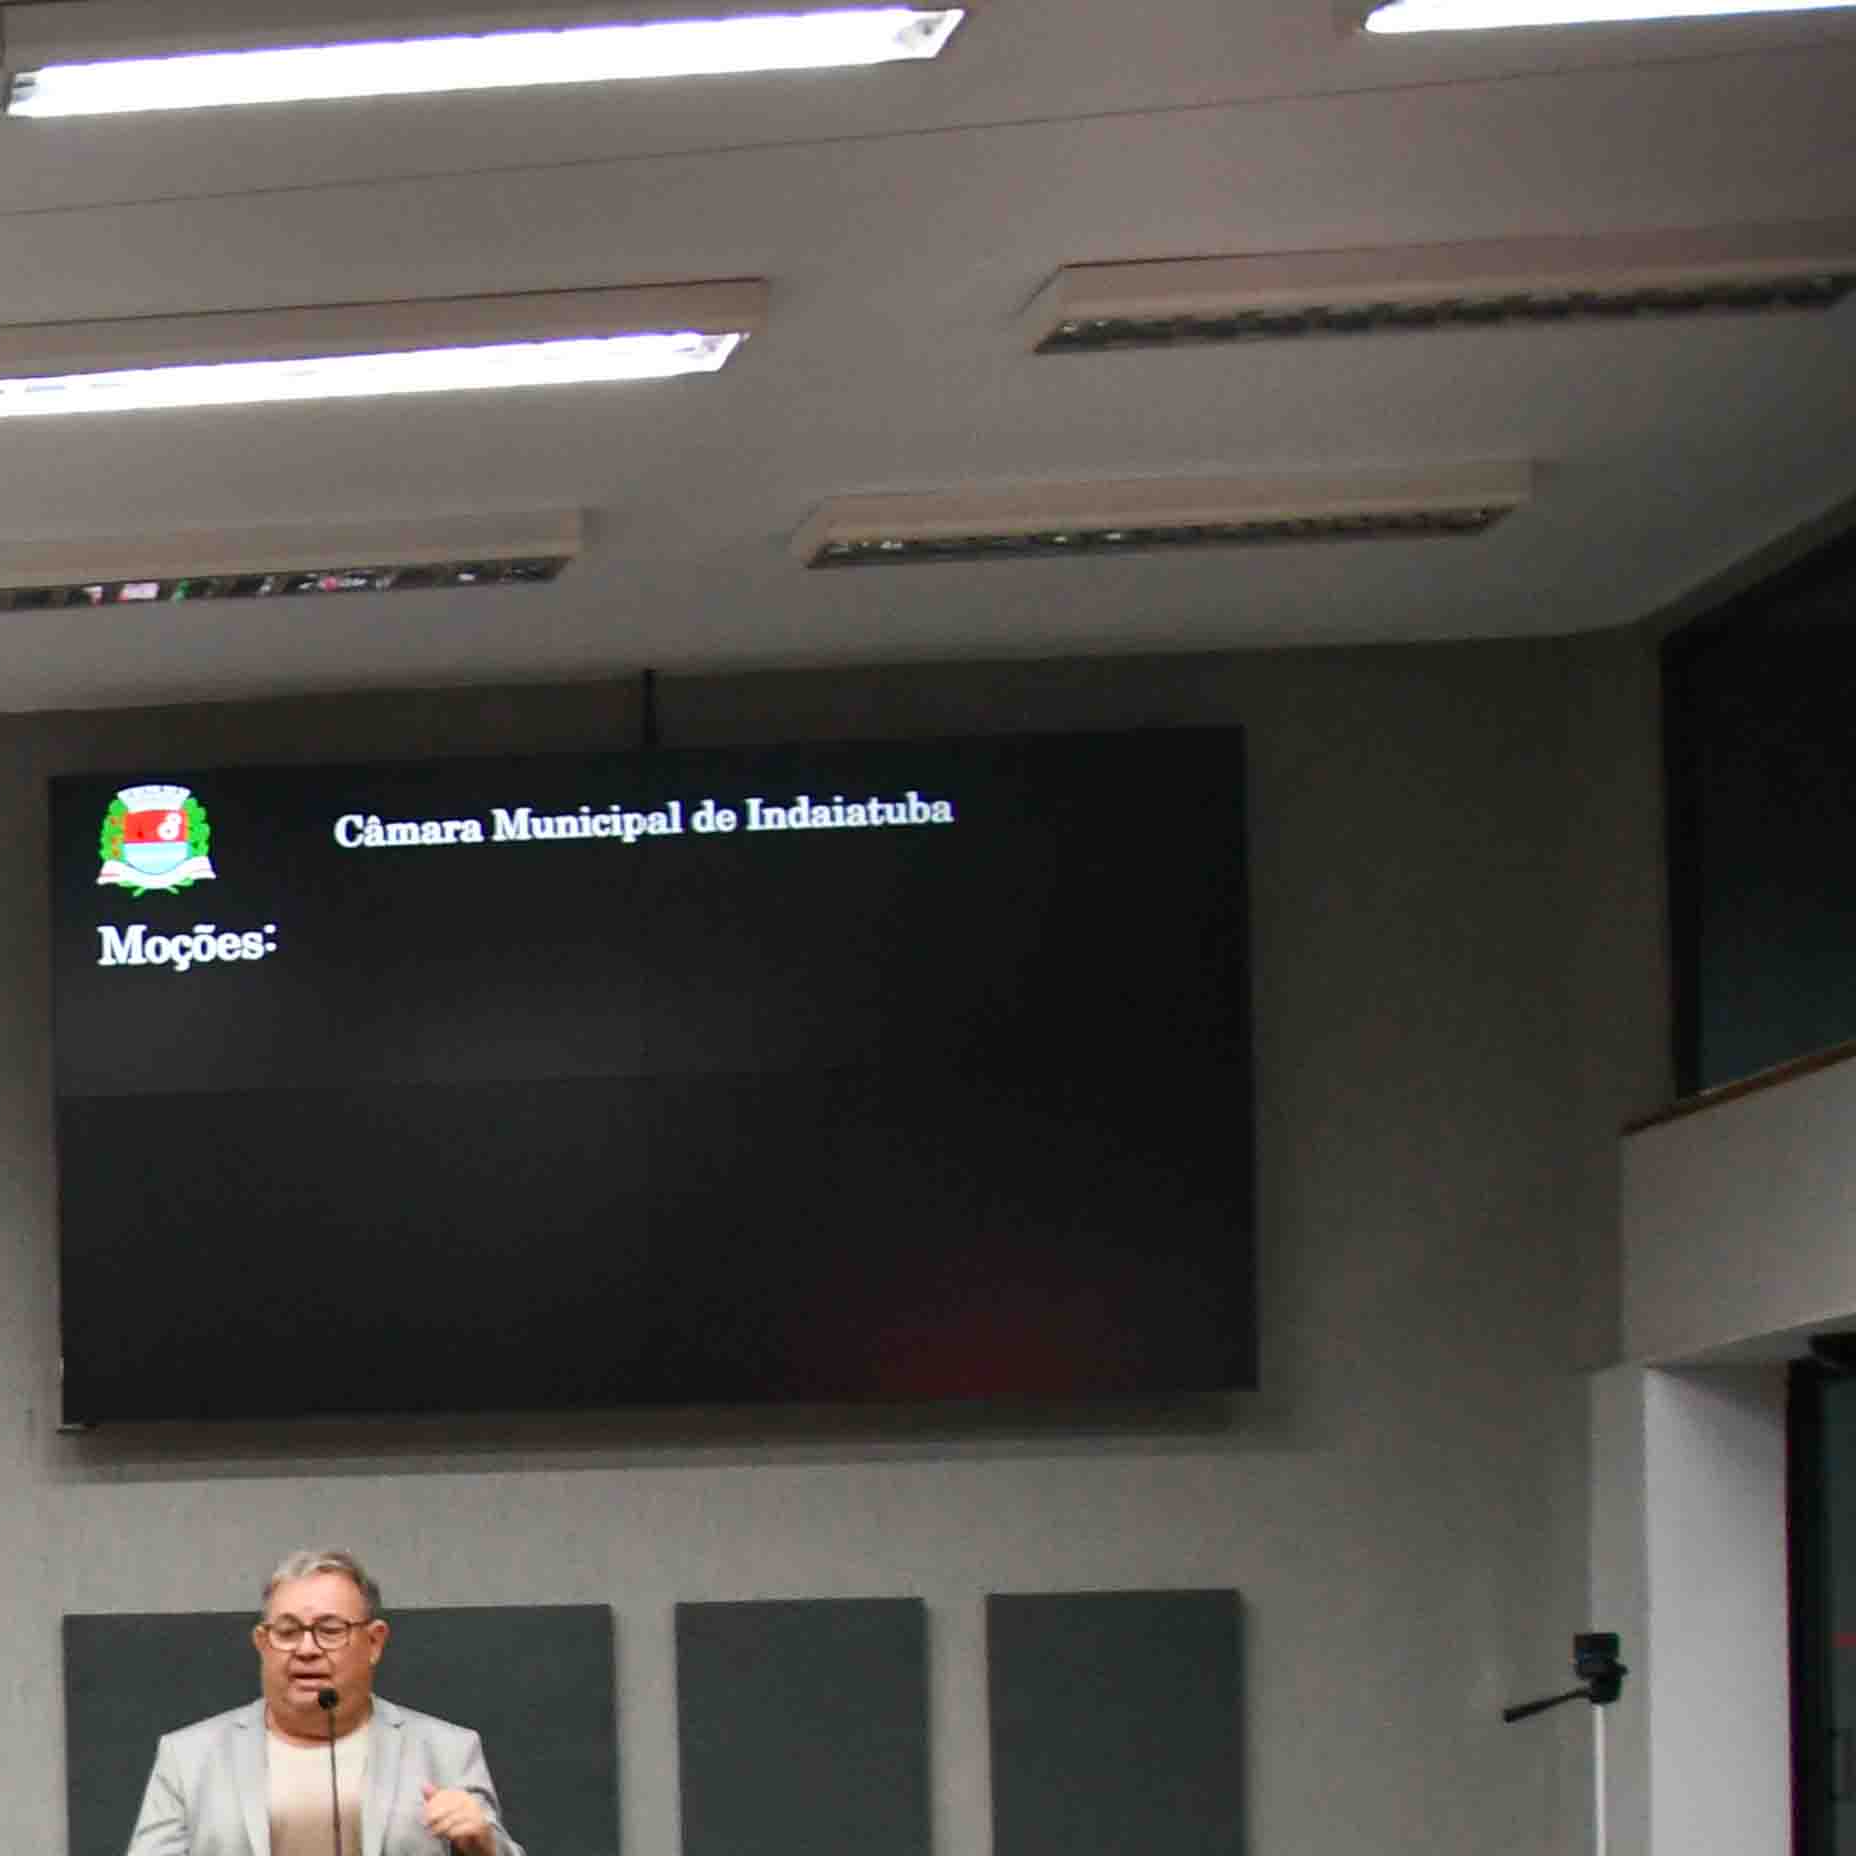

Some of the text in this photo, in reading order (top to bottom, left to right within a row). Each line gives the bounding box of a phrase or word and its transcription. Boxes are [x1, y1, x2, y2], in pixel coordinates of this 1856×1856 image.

[335, 791, 954, 849] Câmara Municipal de Indaiatuba
[98, 923, 277, 972] Moções:
